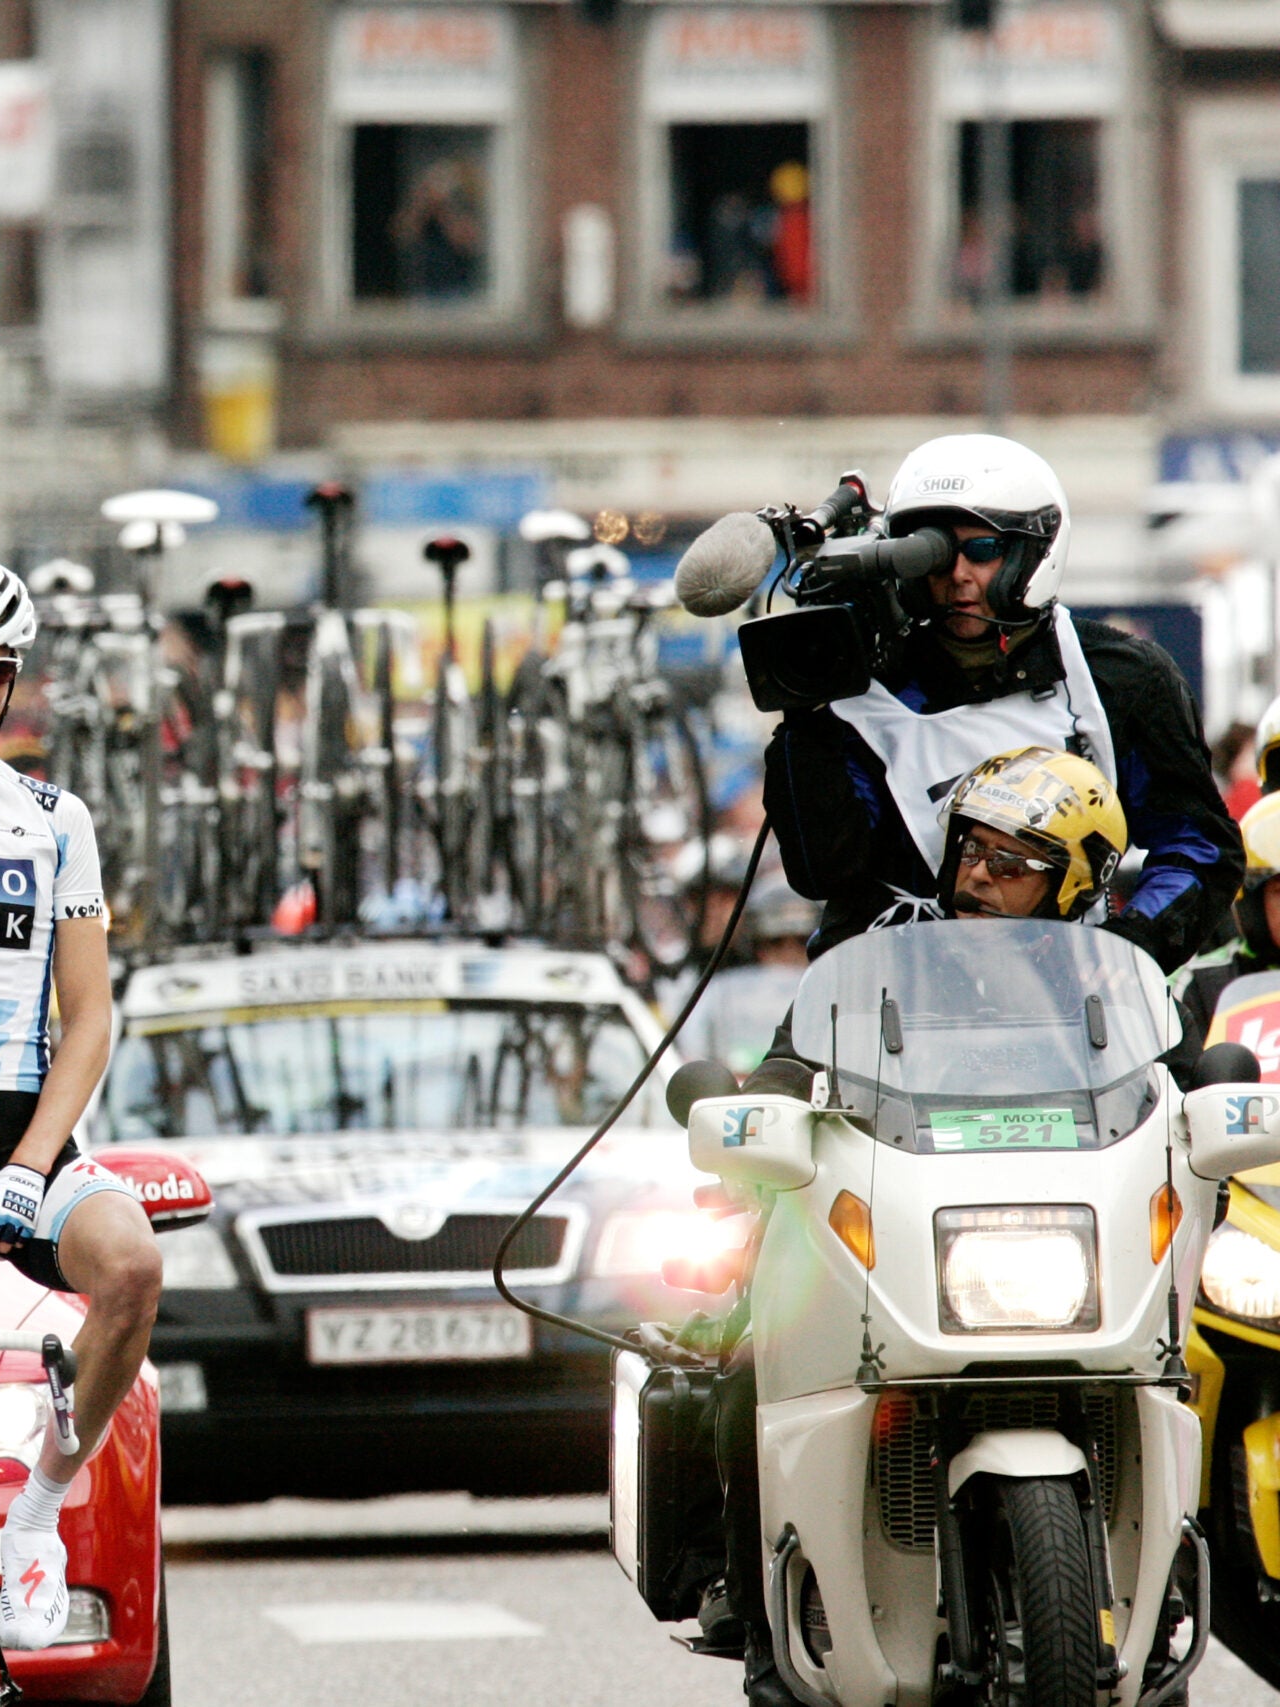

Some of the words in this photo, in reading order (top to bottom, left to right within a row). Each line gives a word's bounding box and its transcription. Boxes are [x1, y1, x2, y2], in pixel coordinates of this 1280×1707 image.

[922, 478, 966, 492] SHOEI
[21, 778, 58, 793] AXO
[33, 792, 54, 808] NK
[1003, 1113, 1063, 1123] MOTO
[977, 1124, 1053, 1145] 521
[126, 1172, 195, 1202] koda
[6, 1192, 36, 1209] SAXO
[4, 1200, 34, 1219] BANK
